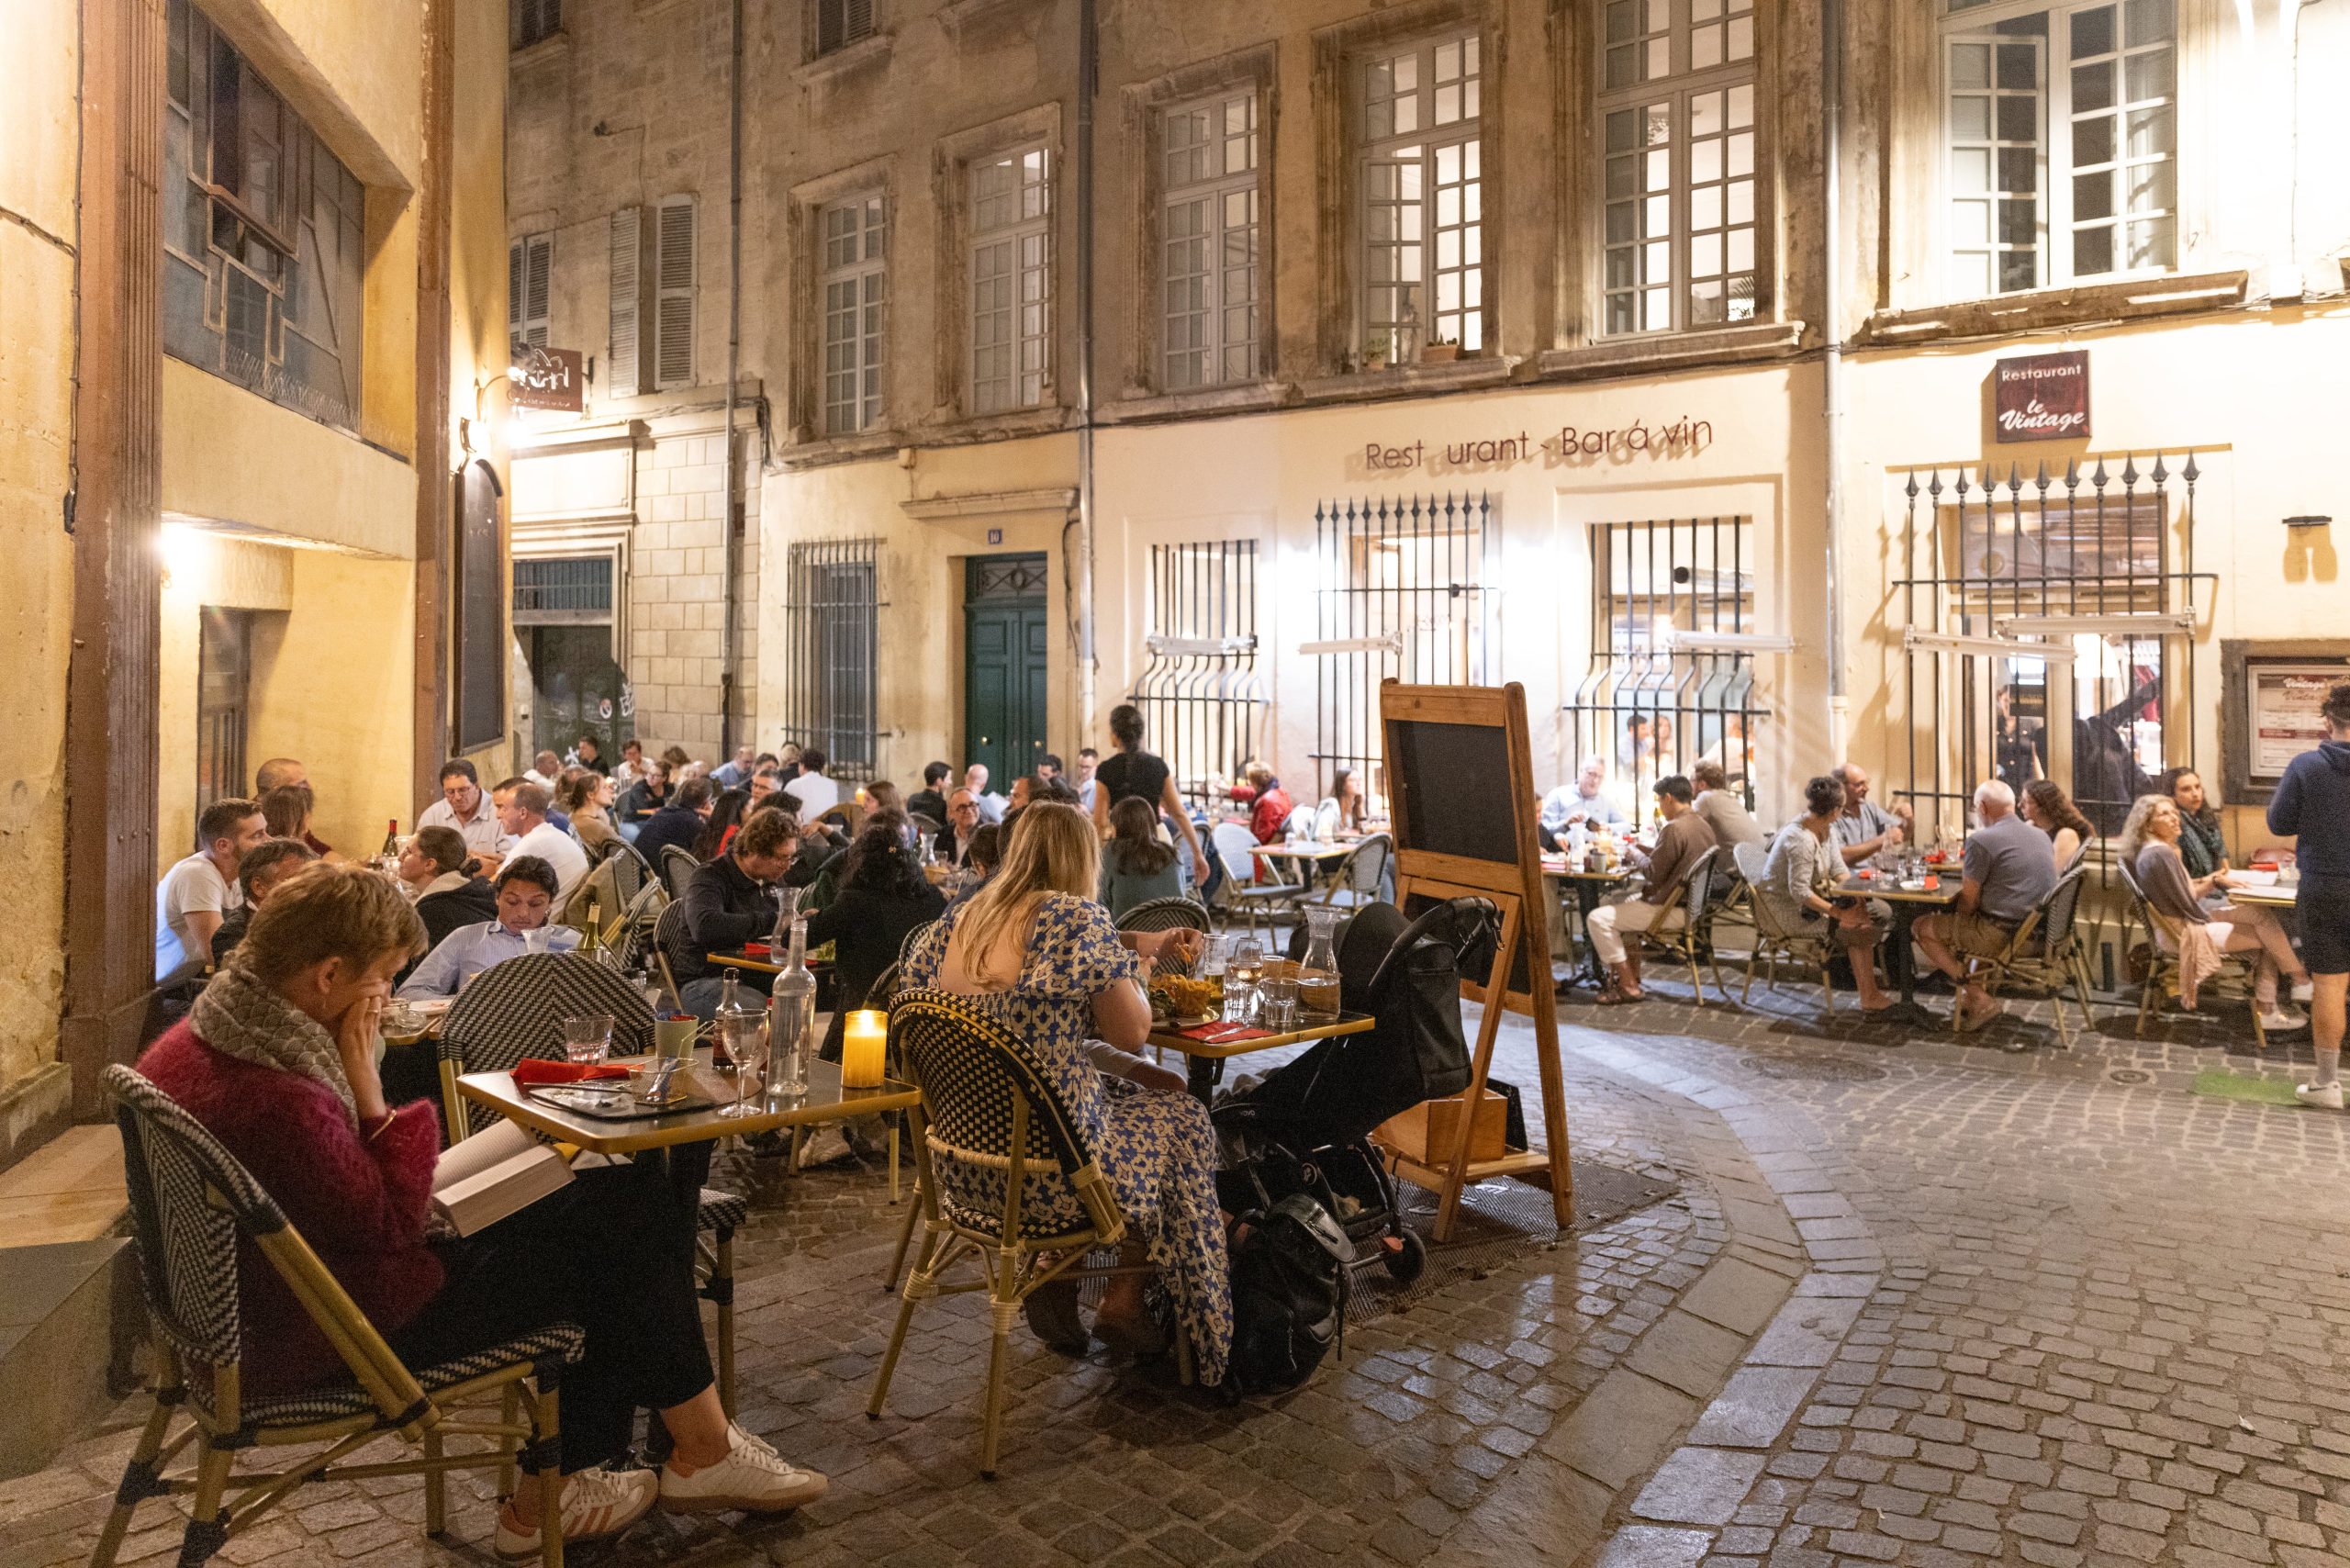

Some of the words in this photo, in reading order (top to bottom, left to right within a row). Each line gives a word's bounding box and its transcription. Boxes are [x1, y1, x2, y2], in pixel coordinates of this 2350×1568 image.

[2001, 364, 2082, 382] Restaurant
[2027, 399, 2045, 414] le
[1998, 409, 2086, 432] Vintage
[1561, 426, 1617, 456] Bar
[1662, 414, 1714, 446] vin
